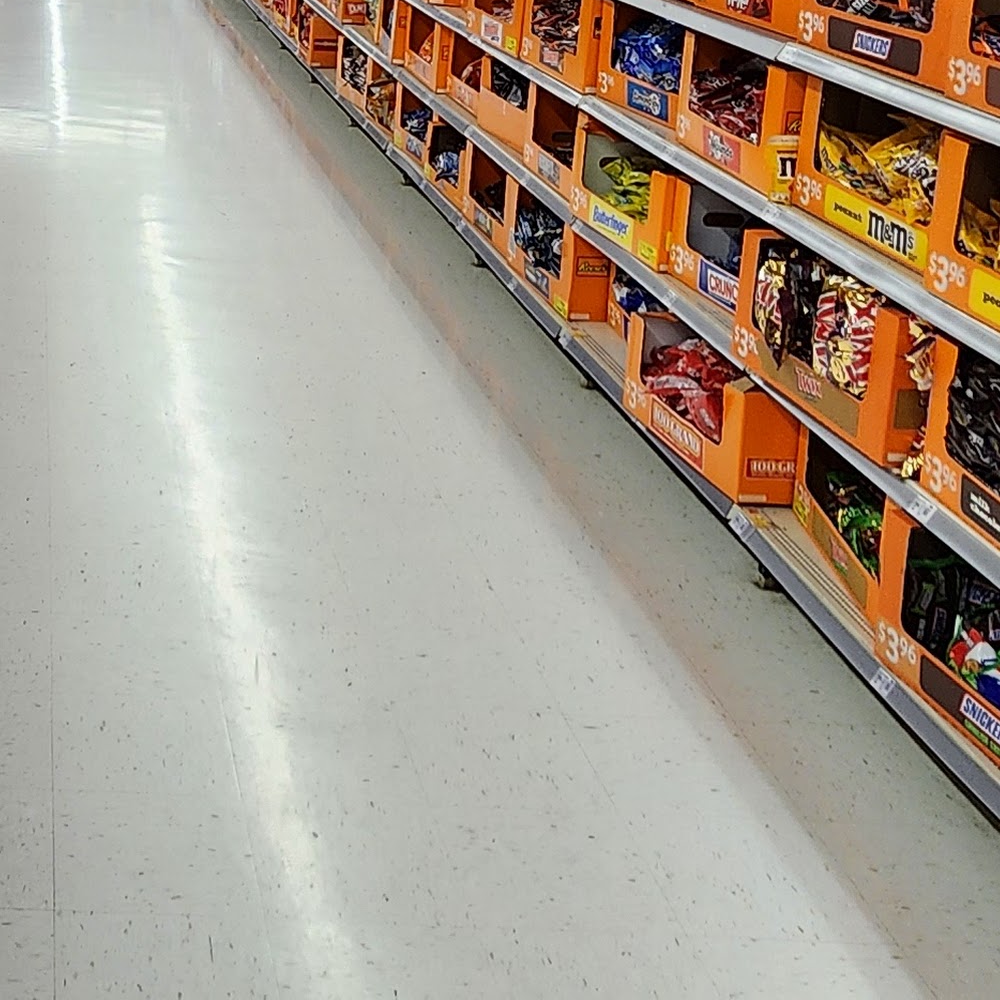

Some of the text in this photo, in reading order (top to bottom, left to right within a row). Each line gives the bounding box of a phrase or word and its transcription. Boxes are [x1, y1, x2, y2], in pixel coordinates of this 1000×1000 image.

[799, 10, 824, 42] $396
[855, 32, 890, 57] SNICKERS
[948, 57, 982, 95] $396
[795, 173, 823, 206] $396
[593, 205, 629, 236] Butterfinger
[833, 201, 863, 223] peanut
[669, 243, 695, 274] $396
[929, 252, 966, 292] $396
[653, 406, 701, 454] 100 GRAND
[924, 453, 957, 493] $396
[878, 621, 917, 665] $396
